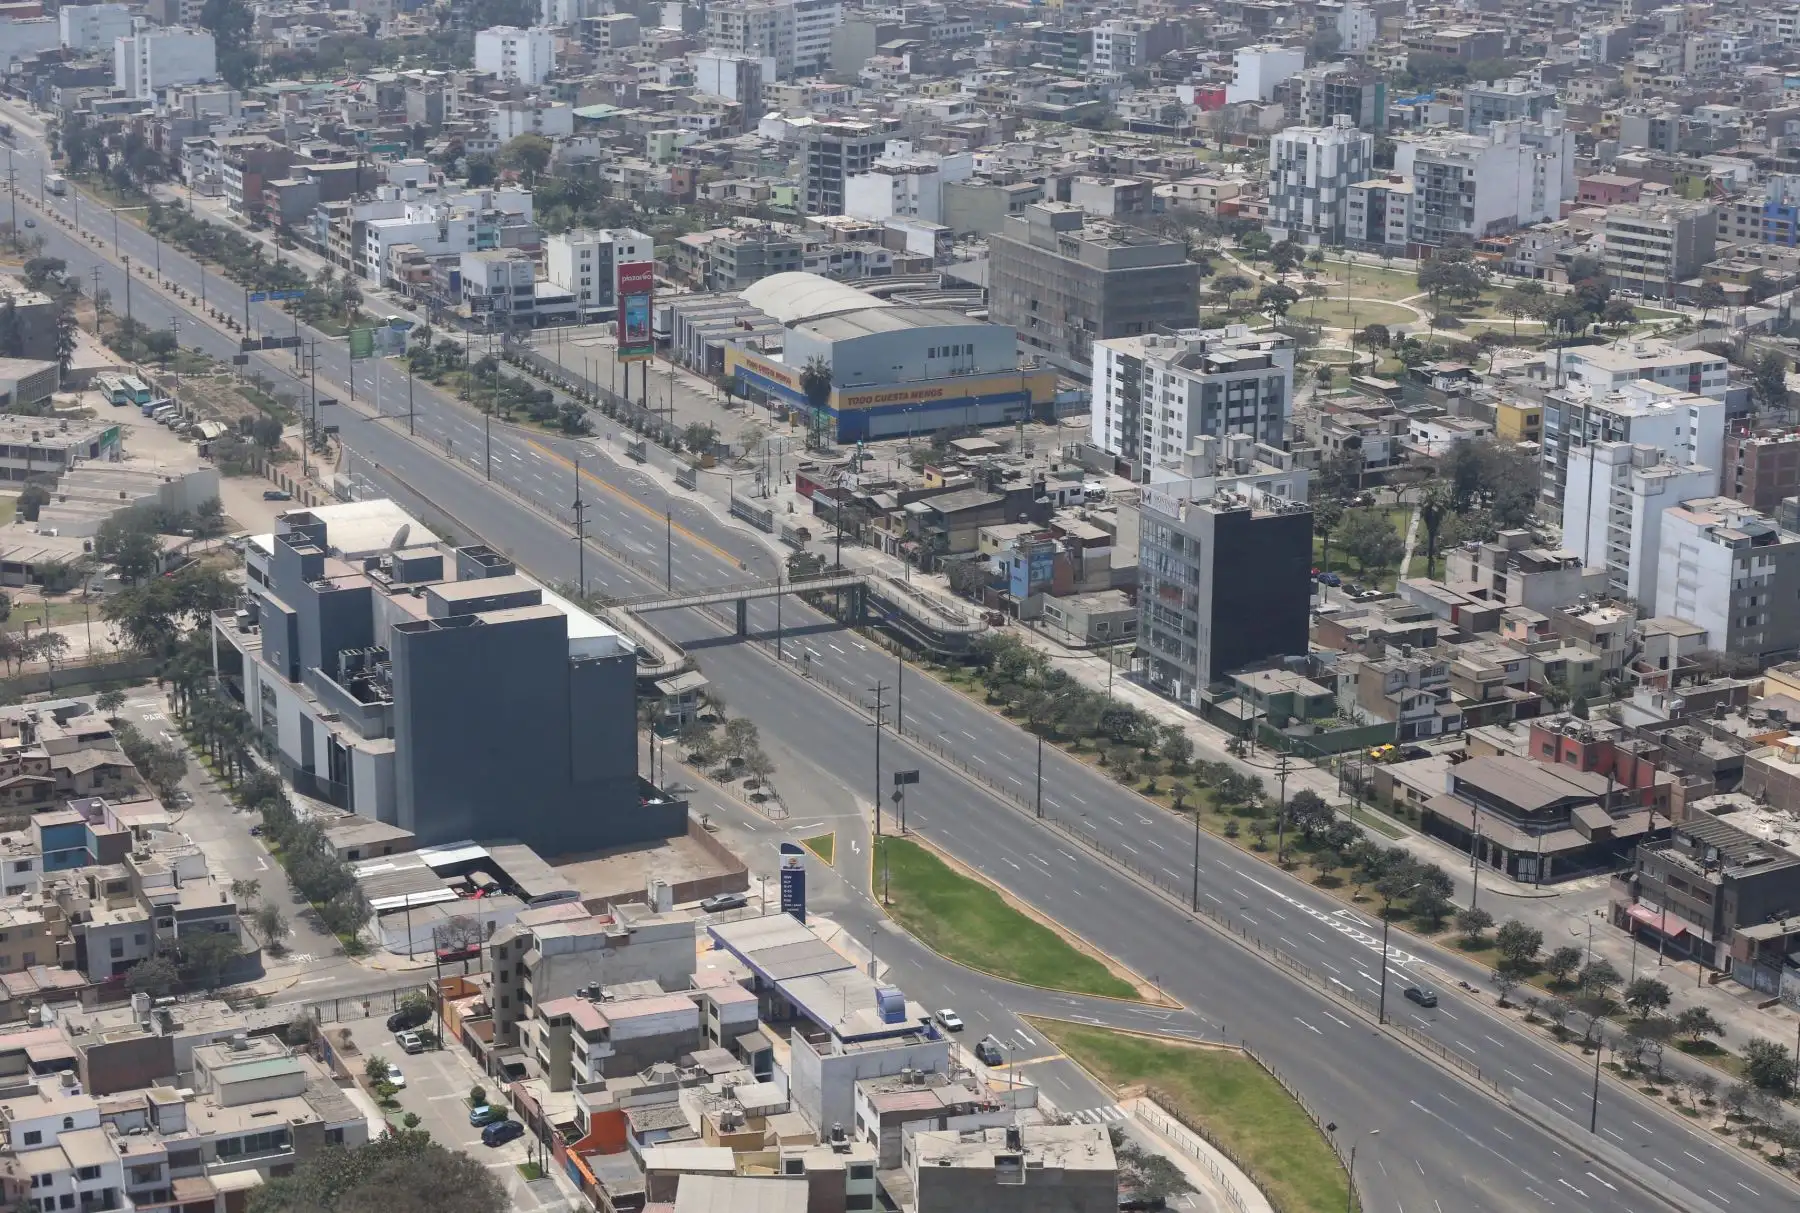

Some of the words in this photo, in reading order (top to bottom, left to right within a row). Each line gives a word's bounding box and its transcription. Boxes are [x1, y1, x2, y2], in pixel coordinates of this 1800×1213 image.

[848, 396, 872, 405] TODO
[874, 392, 909, 403] CUESTA
[909, 388, 943, 399] MENOS
